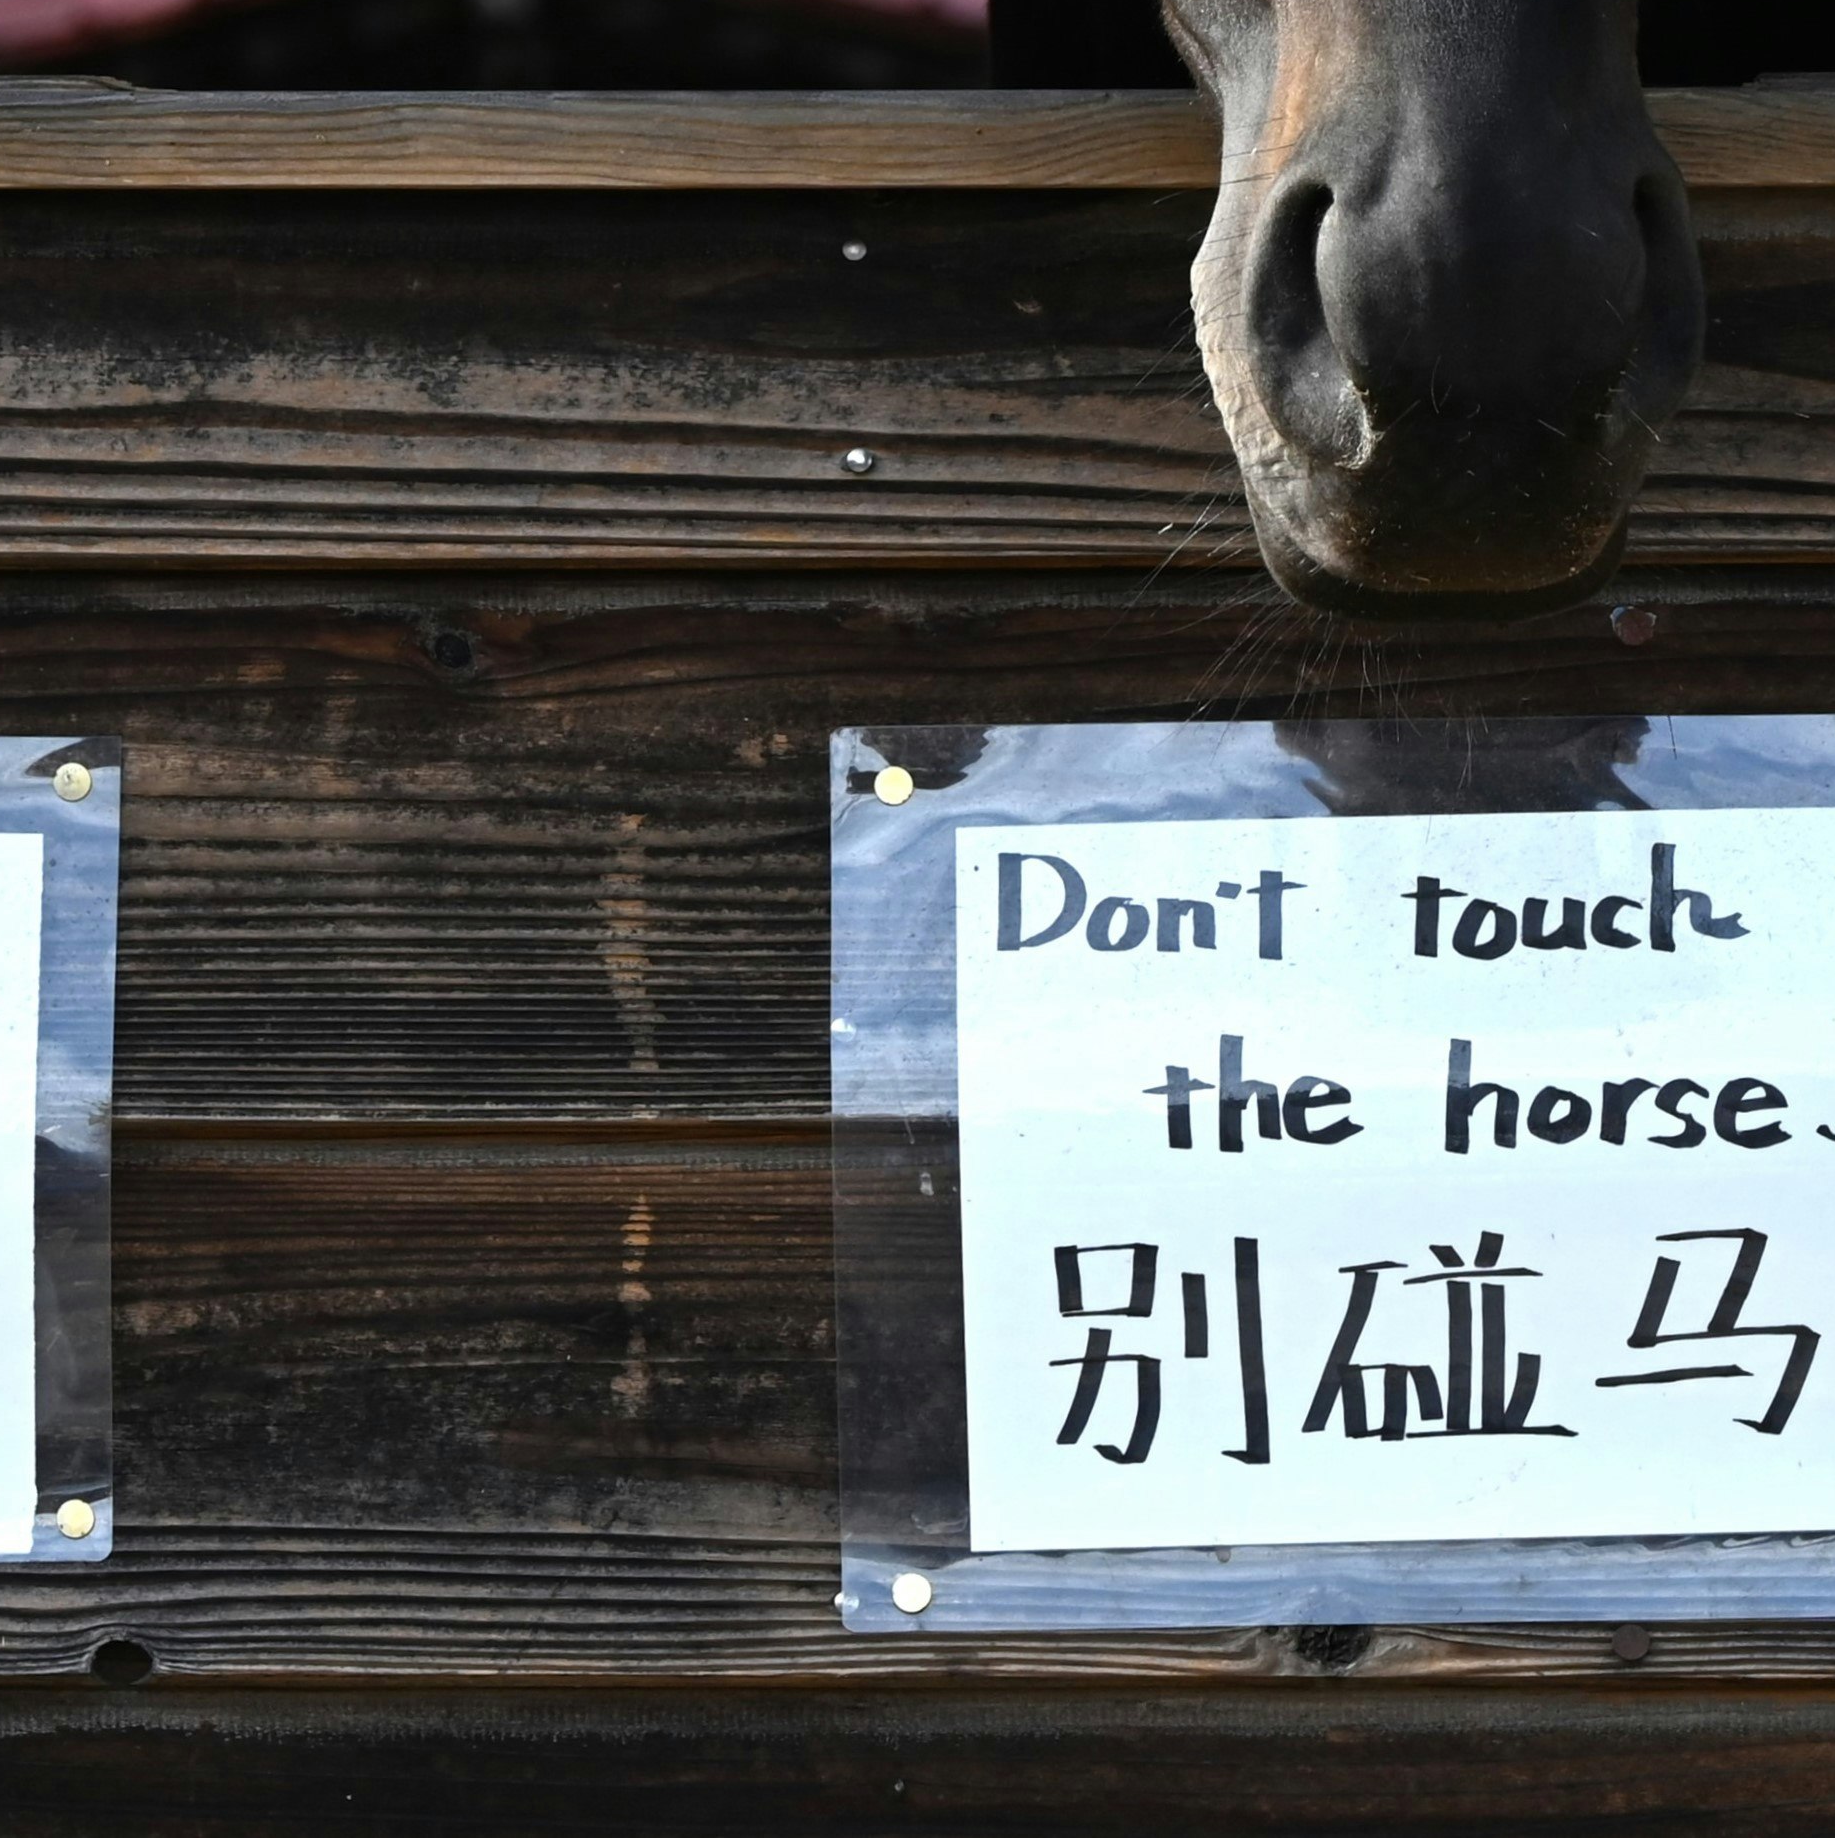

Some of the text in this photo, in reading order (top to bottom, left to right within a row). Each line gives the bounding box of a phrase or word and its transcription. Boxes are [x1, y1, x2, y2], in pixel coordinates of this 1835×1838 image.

[997, 842, 1751, 961] Don't touch
[1143, 1034, 1365, 1153] the
[1049, 1227, 1821, 1465] 别碰马
